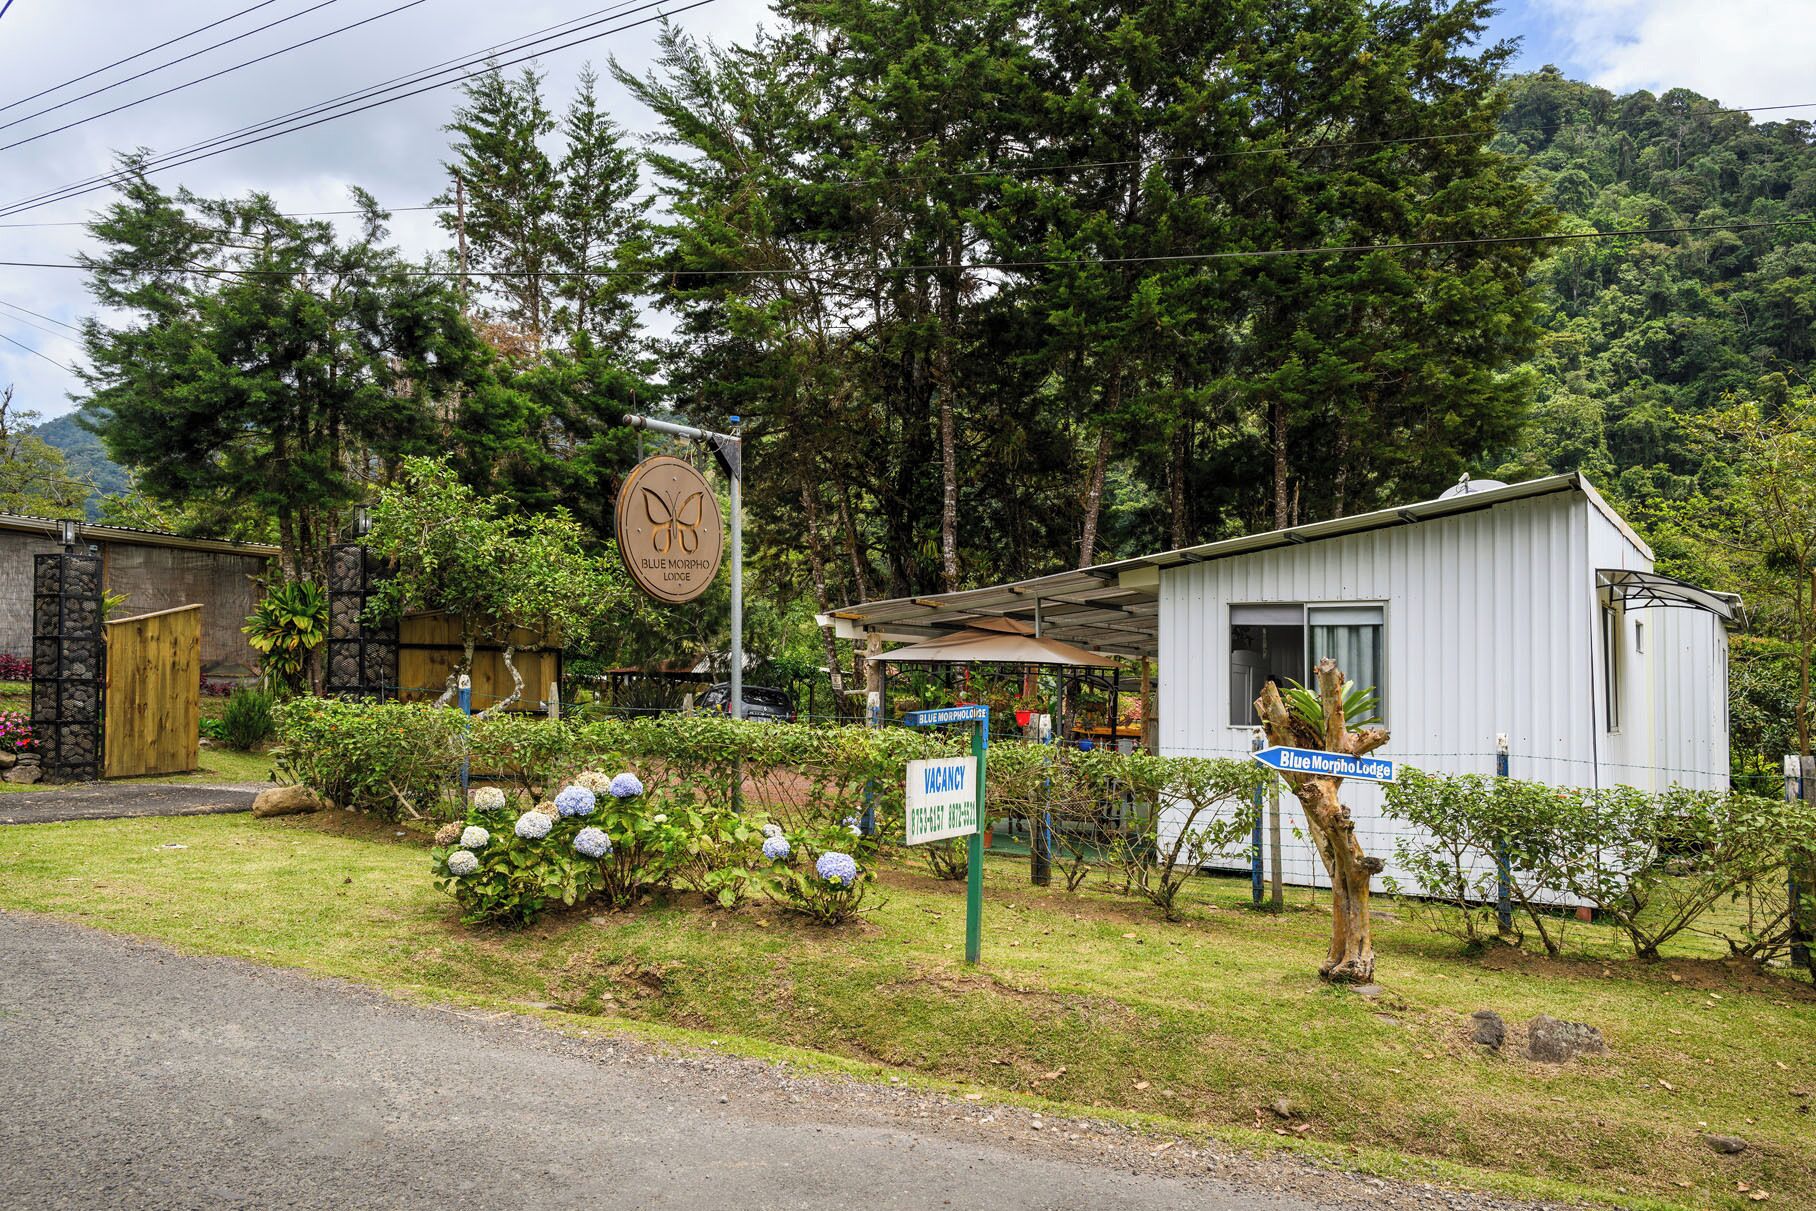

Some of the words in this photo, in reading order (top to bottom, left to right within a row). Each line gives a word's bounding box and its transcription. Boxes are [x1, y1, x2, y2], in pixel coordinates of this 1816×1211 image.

[641, 558, 667, 569] BLUE
[668, 559, 710, 570] MORPHO
[663, 572, 691, 581] LODGE
[919, 712, 938, 724] BLUE
[1279, 750, 1311, 769] Blue
[1311, 755, 1356, 775] Morpho
[1356, 760, 1391, 779] Lodge
[924, 765, 966, 795] VACANCY
[911, 805, 945, 836] 8753-6157
